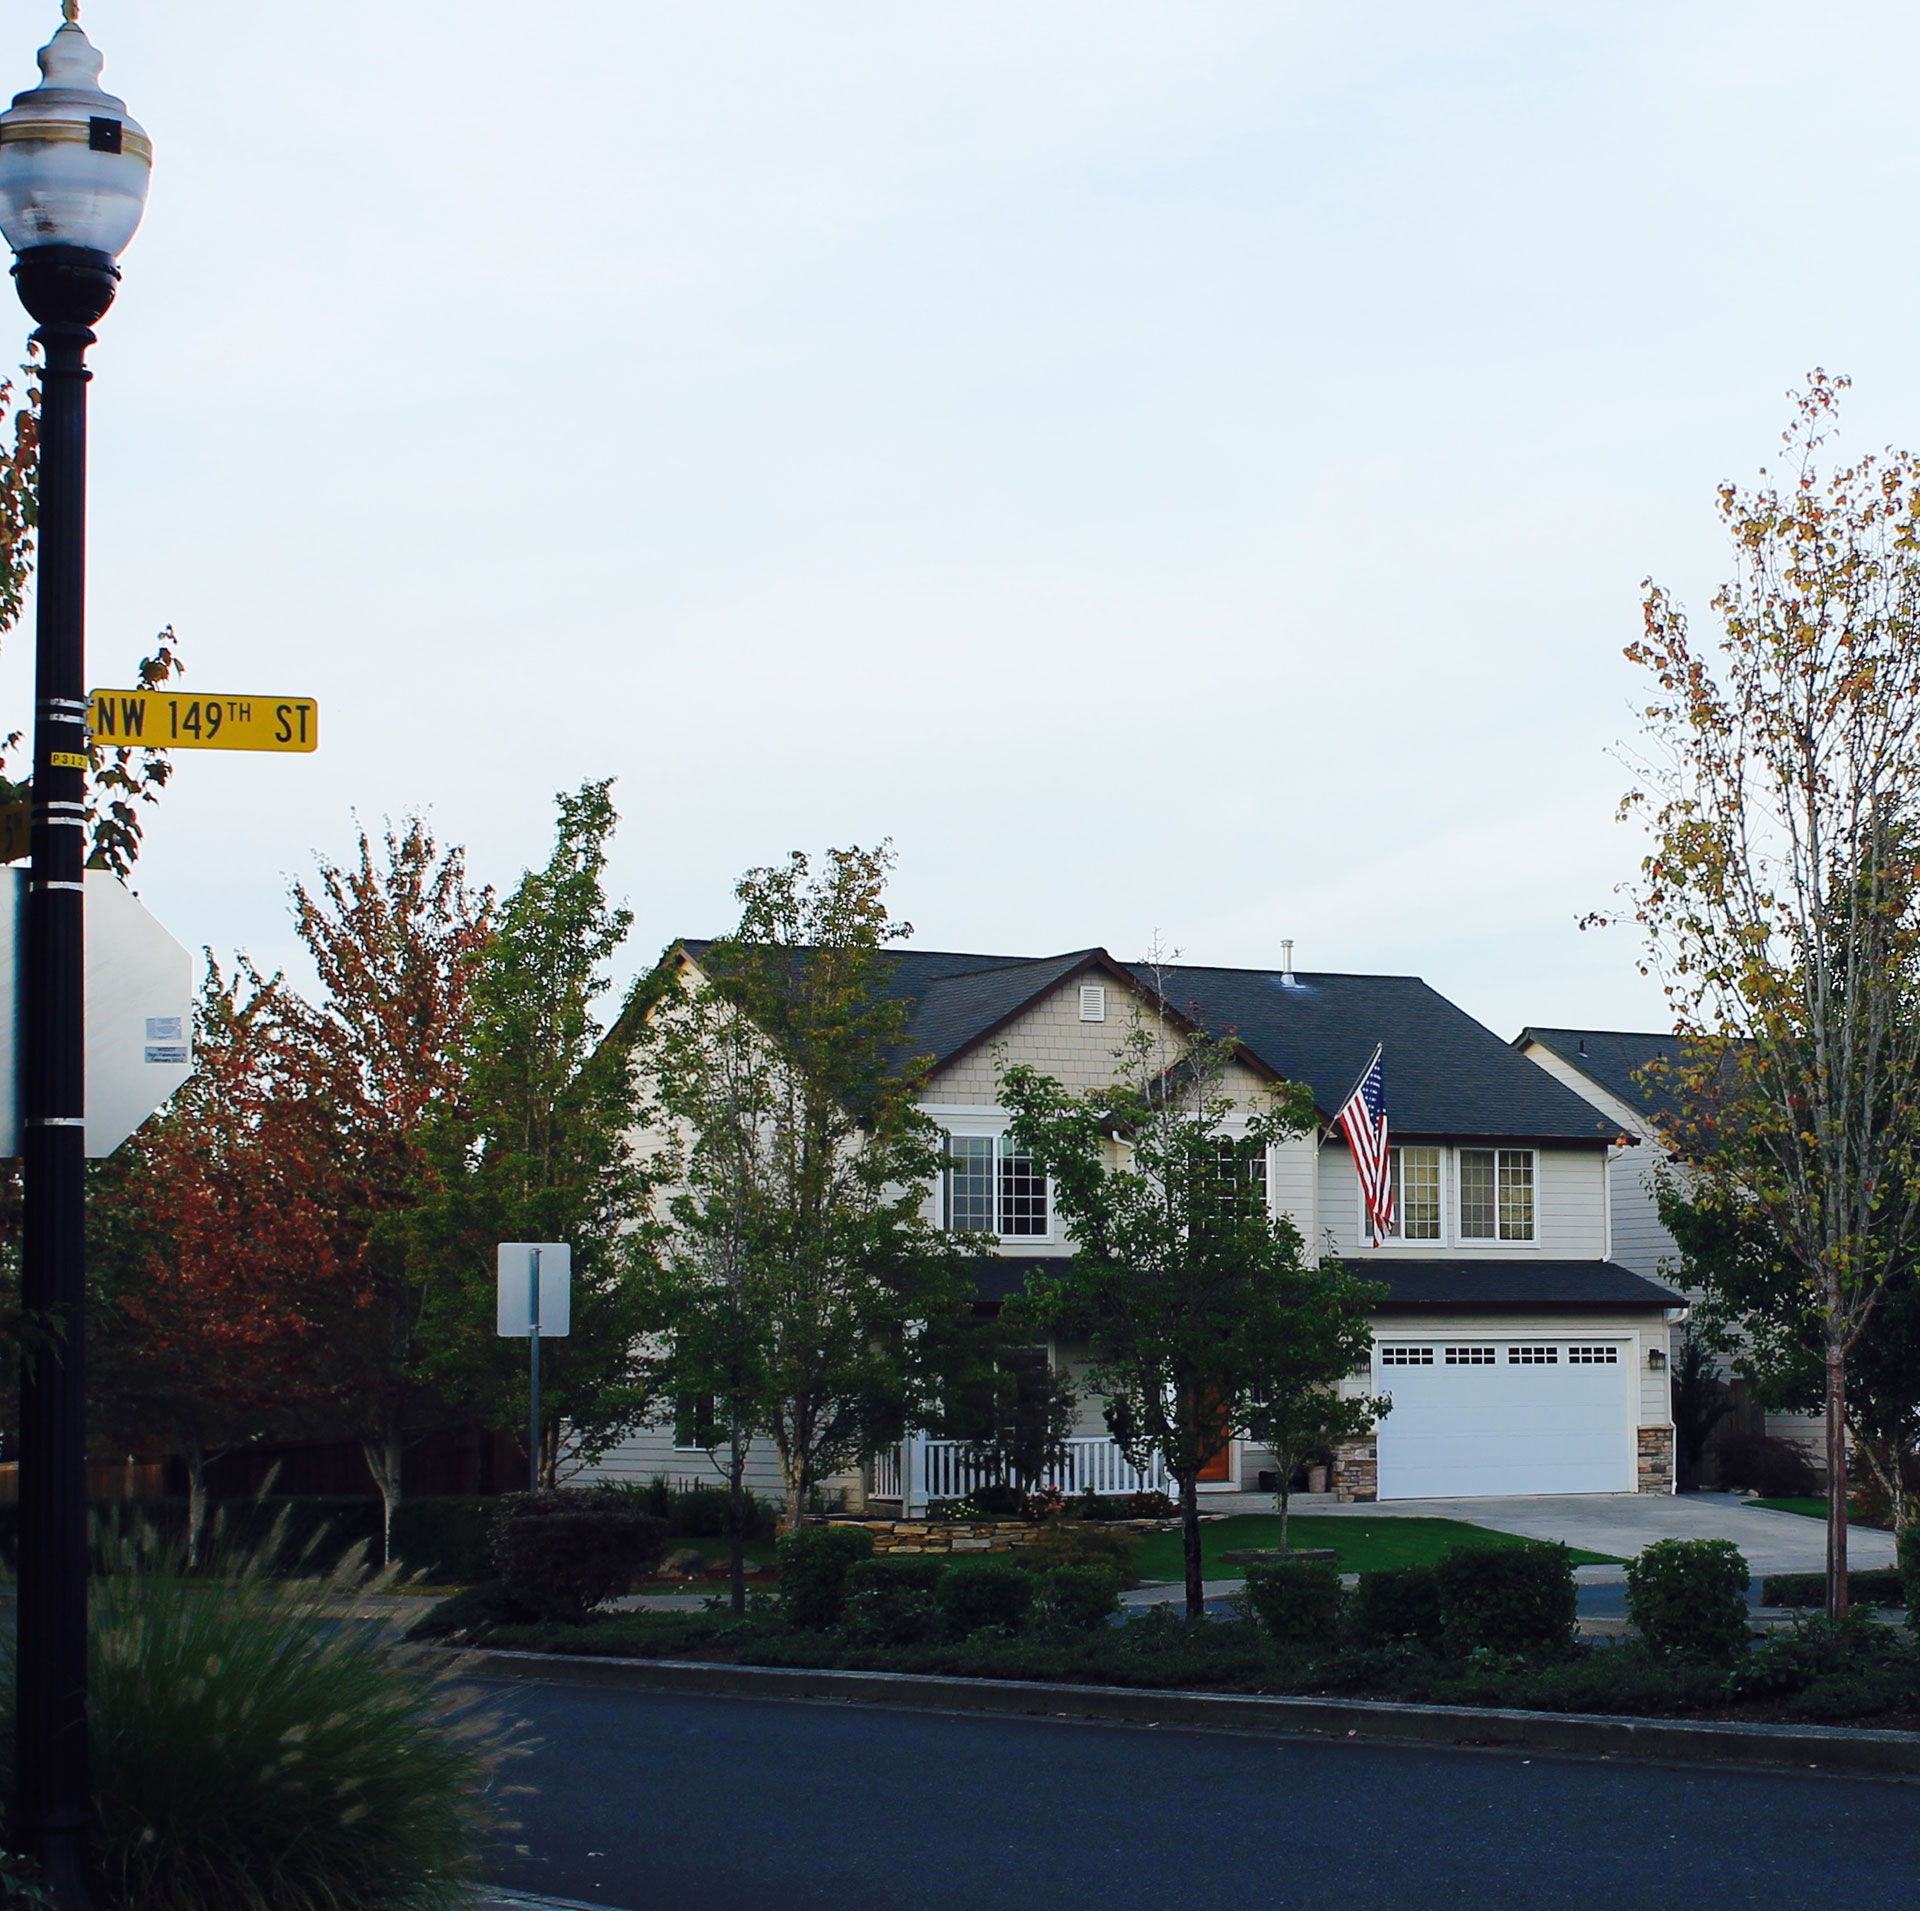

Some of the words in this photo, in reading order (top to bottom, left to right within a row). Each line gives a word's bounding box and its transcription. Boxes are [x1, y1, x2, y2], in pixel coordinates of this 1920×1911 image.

[97, 697, 146, 737] NW
[168, 700, 251, 740] 149TH
[275, 704, 311, 744] ST
